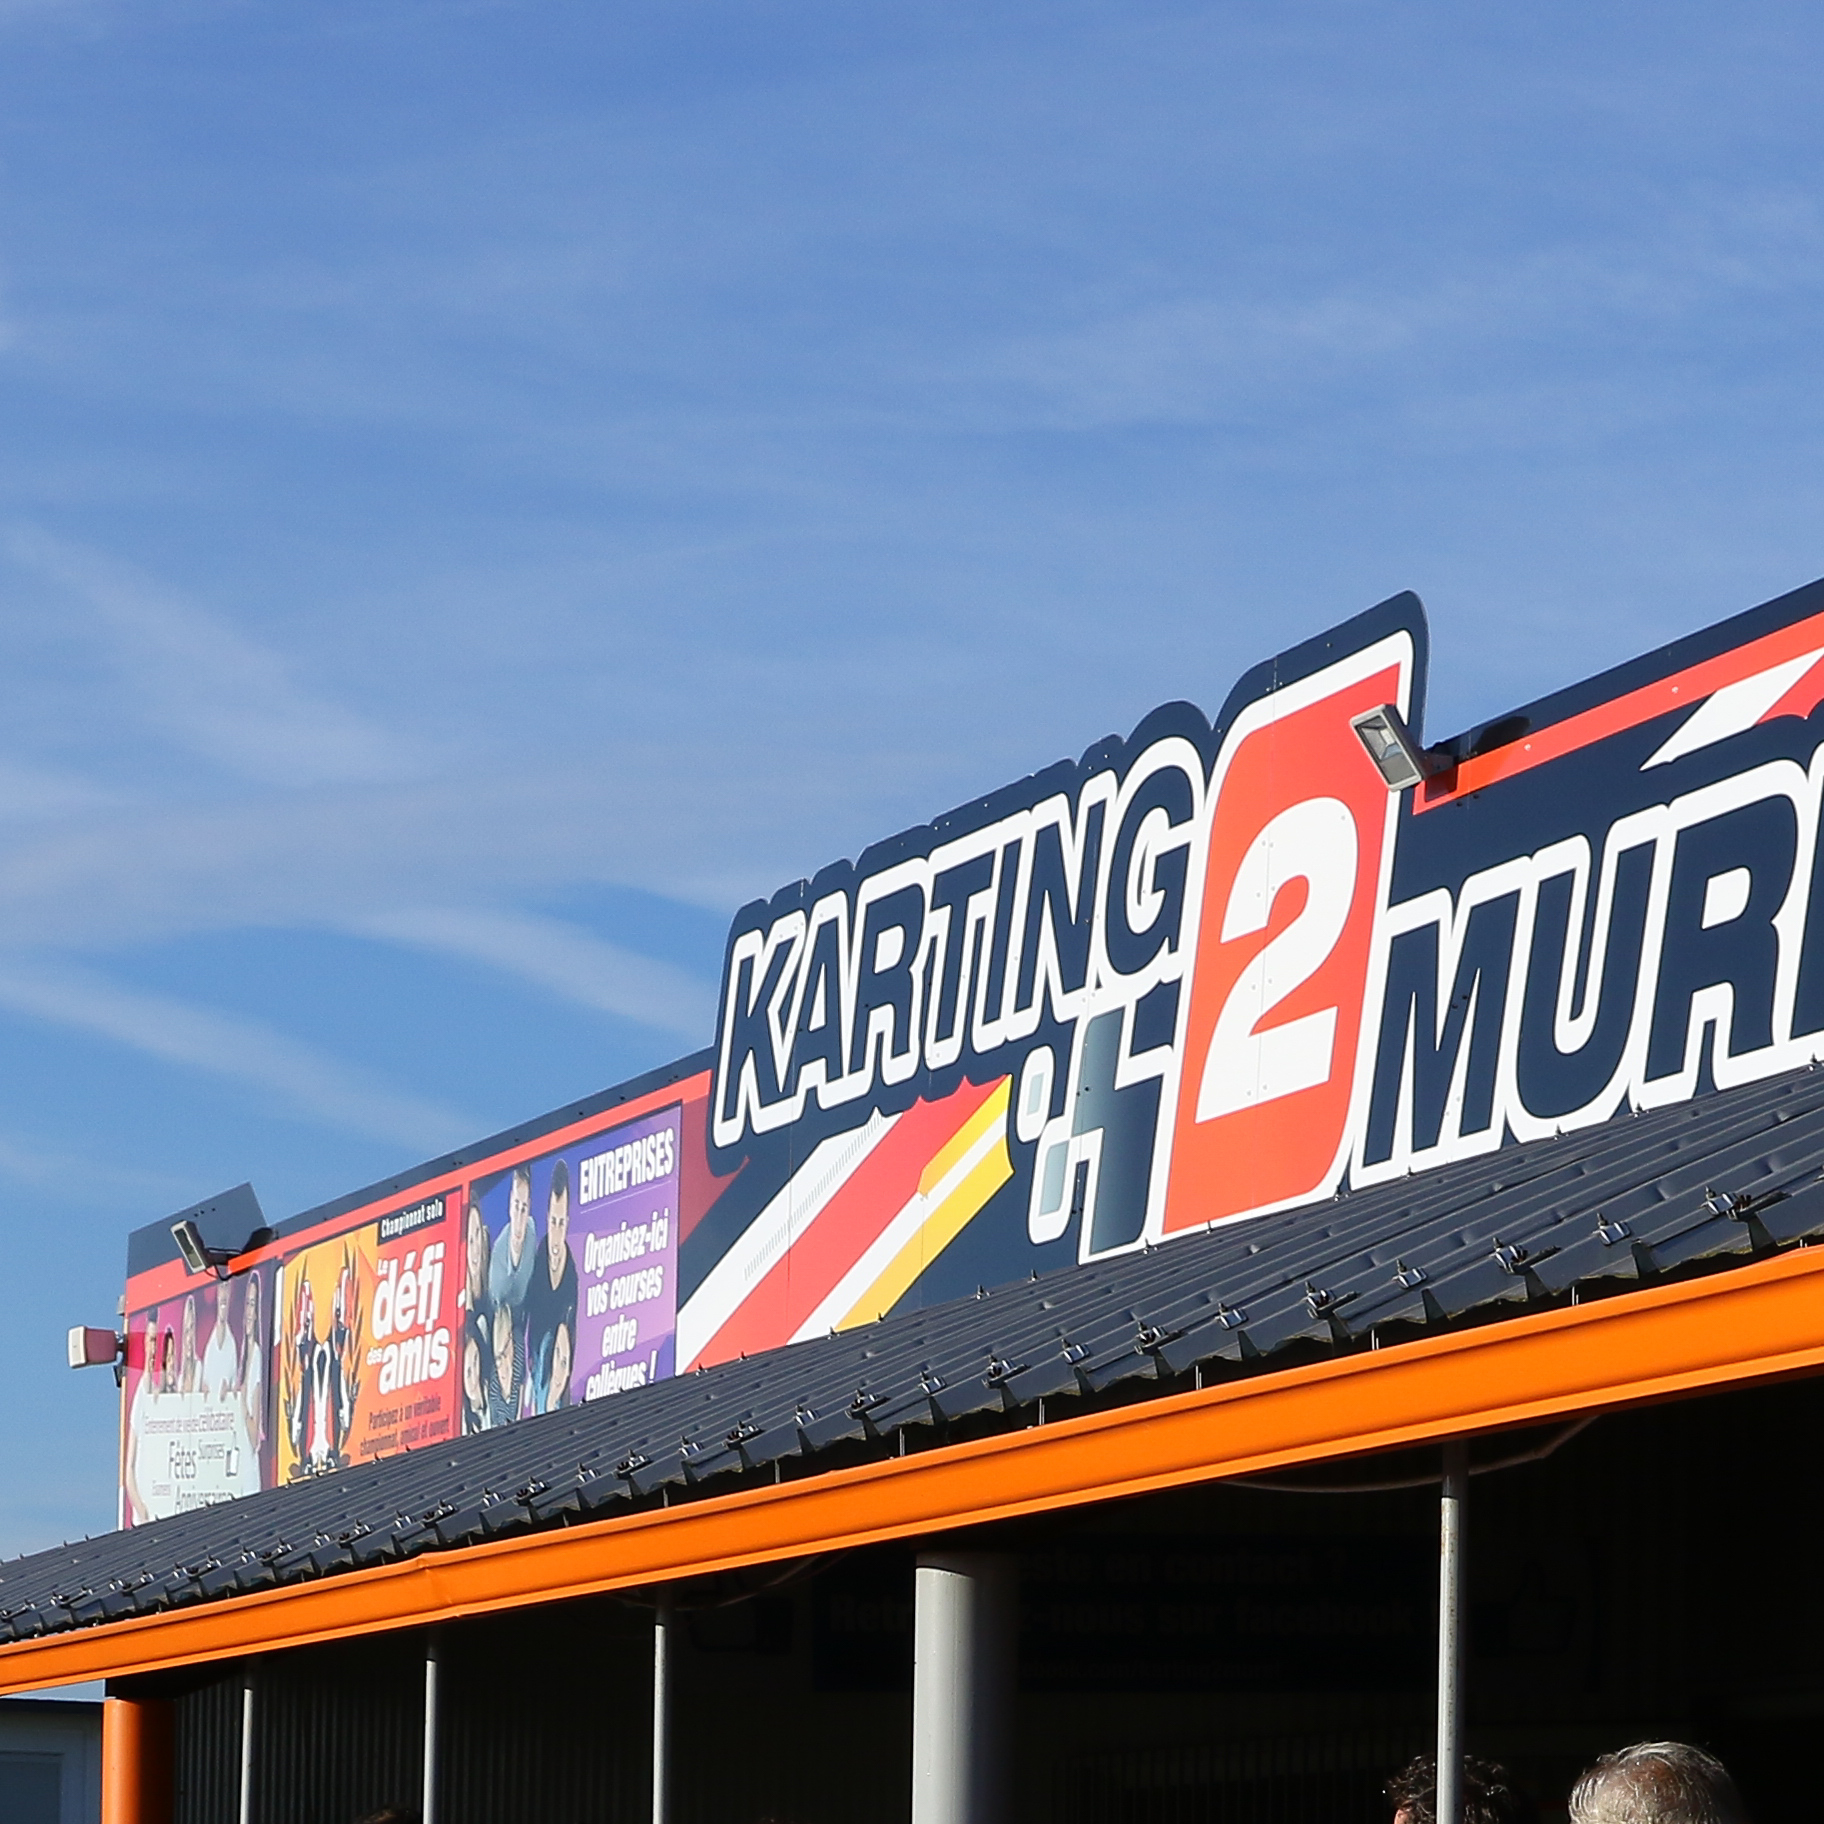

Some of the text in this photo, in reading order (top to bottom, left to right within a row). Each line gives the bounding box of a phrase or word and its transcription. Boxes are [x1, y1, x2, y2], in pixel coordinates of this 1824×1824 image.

[713, 737, 1205, 1148] KARTING
[1195, 796, 1359, 1125] 2
[579, 1127, 674, 1205] ENTREPRISES
[381, 1198, 443, 1238] Championnat solo
[584, 1207, 669, 1278] Organisez-ici
[372, 1241, 445, 1340] défi
[587, 1265, 664, 1317] vos courses
[379, 1327, 450, 1395] amis
[602, 1314, 638, 1357] entre
